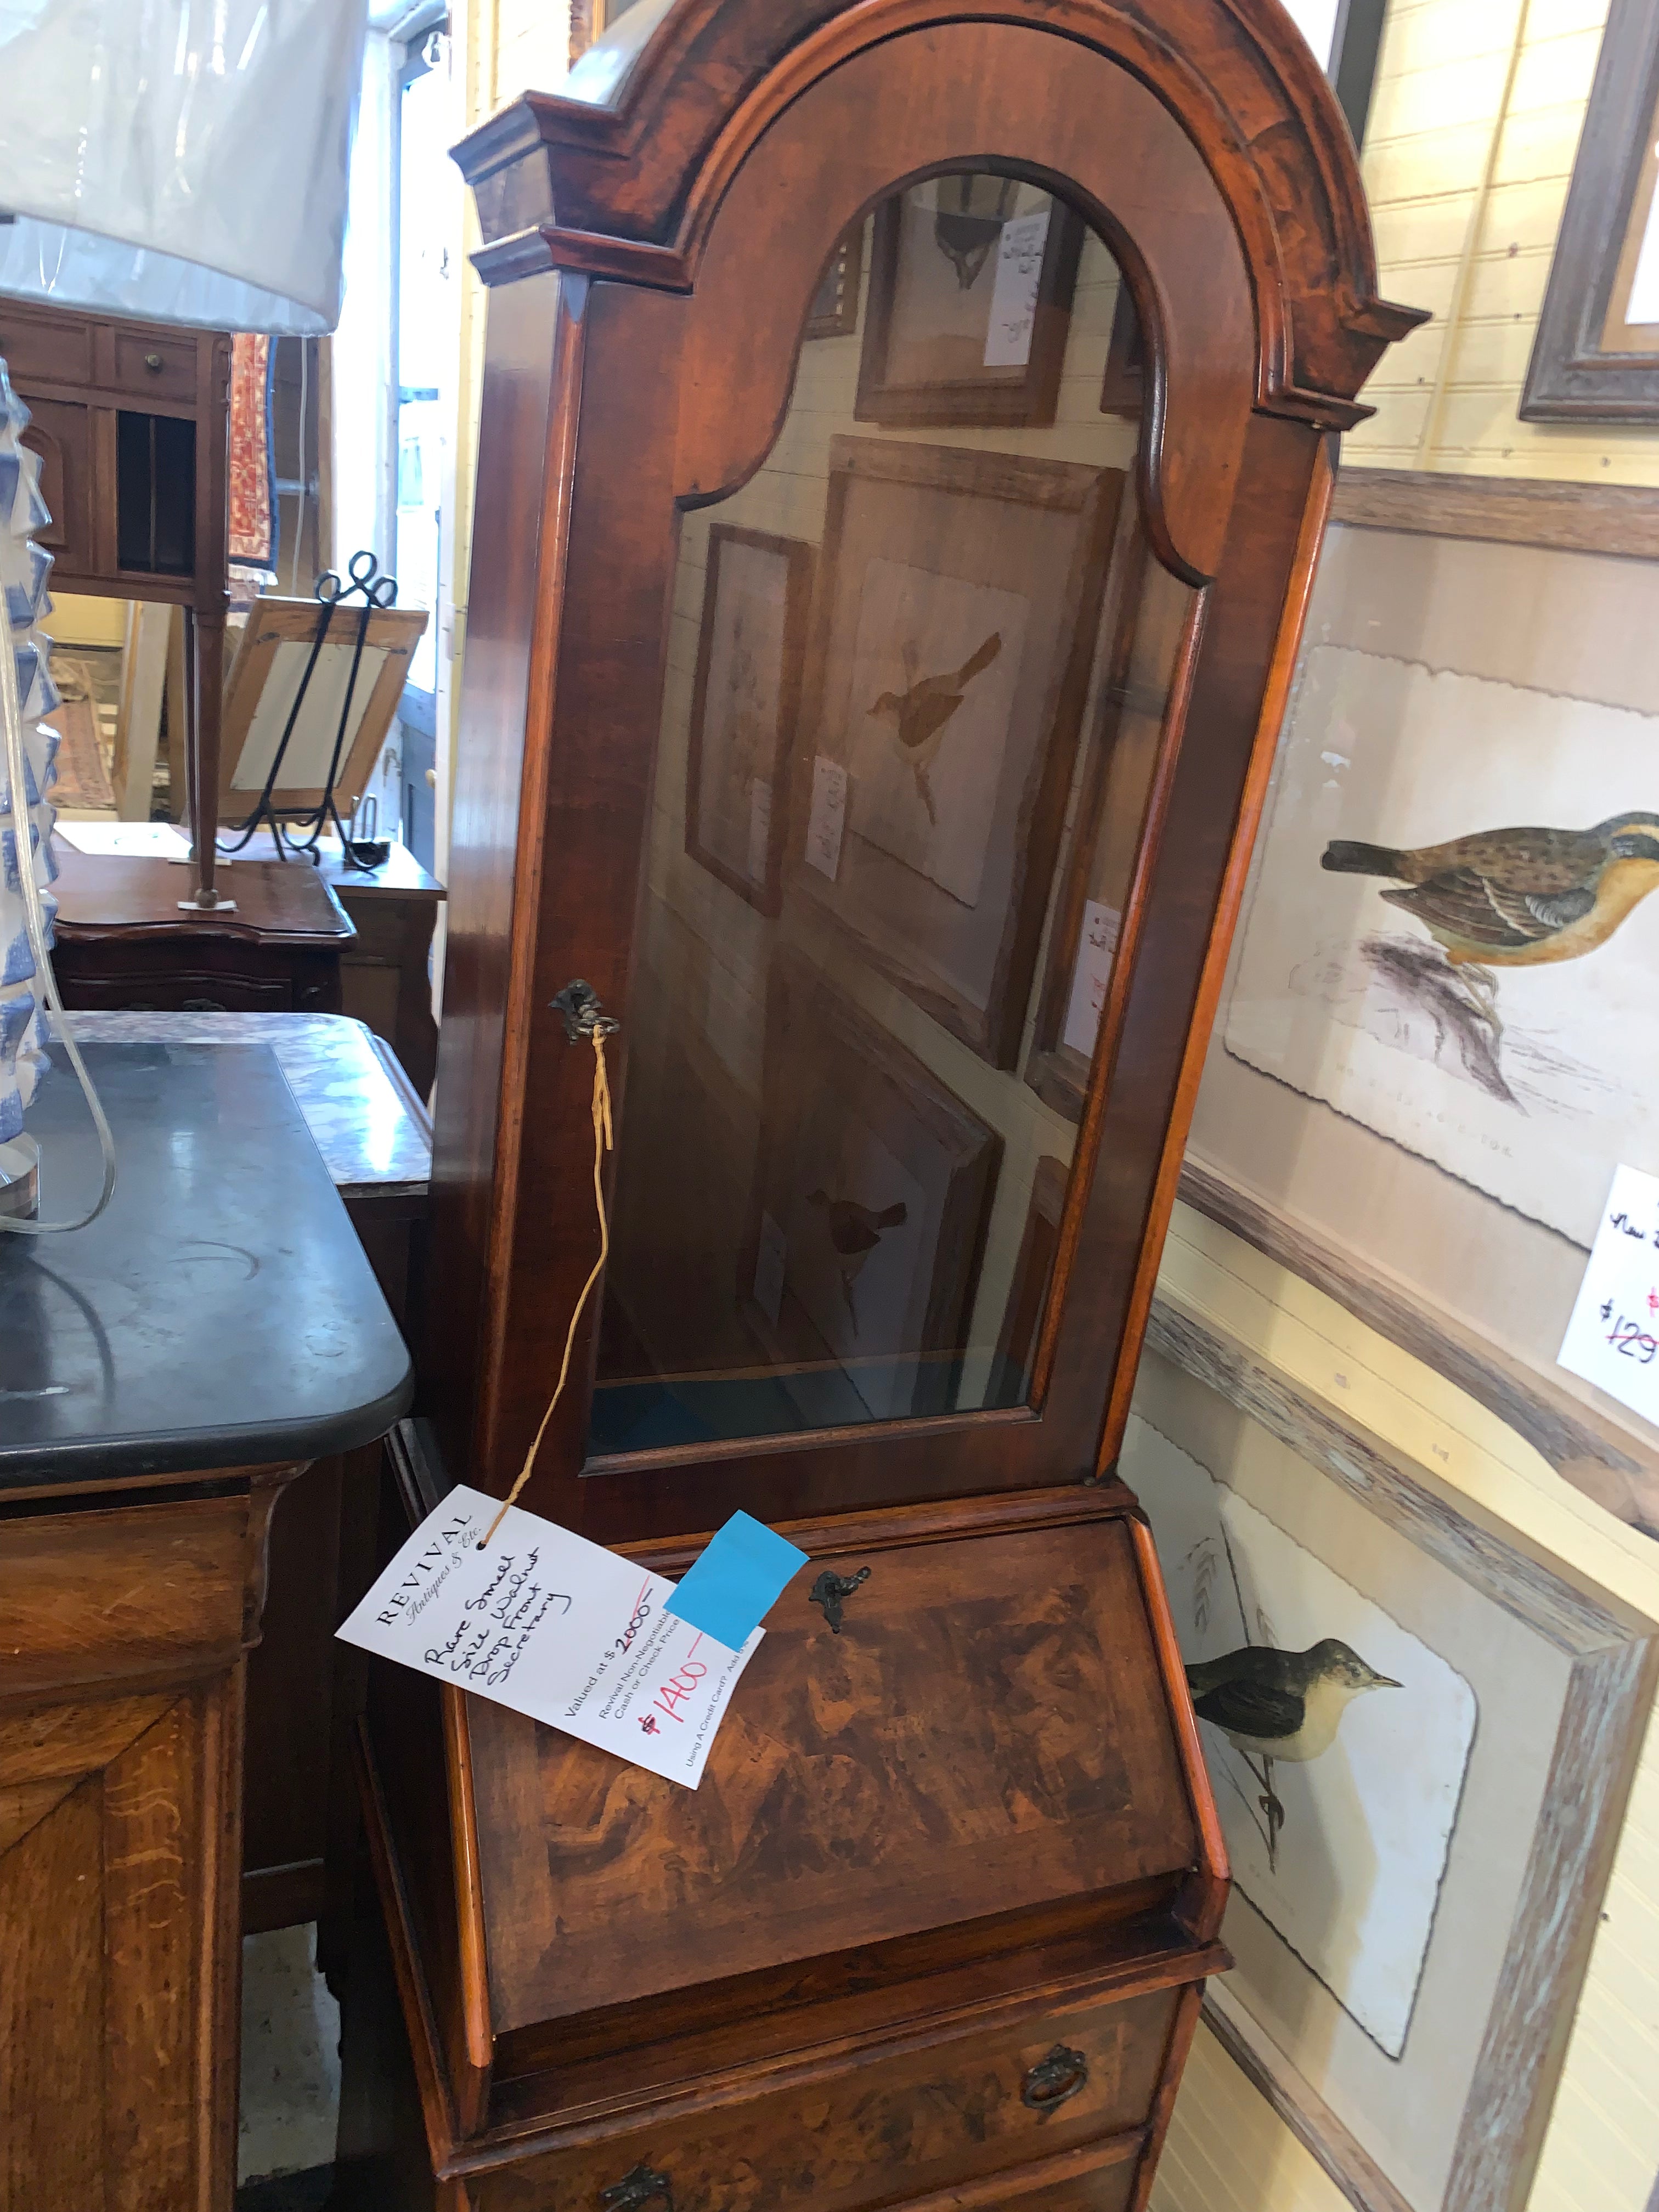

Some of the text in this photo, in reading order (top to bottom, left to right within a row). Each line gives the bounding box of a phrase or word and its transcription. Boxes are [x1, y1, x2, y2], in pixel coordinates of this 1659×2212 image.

[375, 1515, 473, 1627] REVIVAL
[405, 1565, 450, 1627] Antiques
[458, 1527, 482, 1548] Etc.
[424, 1555, 516, 1665] Rare Small
[450, 1547, 539, 1672] Size Walnut
[469, 1582, 542, 1680] Drop Front
[487, 1593, 572, 1686] Secretary
[614, 1618, 680, 1719] Cash or Check Price
[564, 1677, 598, 1717] Valued
[596, 1662, 608, 1675] at
[599, 1683, 624, 1719] Revival
[686, 1742, 702, 1767] Using
[700, 1703, 716, 1731] Credit
[712, 1675, 728, 1702] Card?
[727, 1654, 740, 1673] Add
